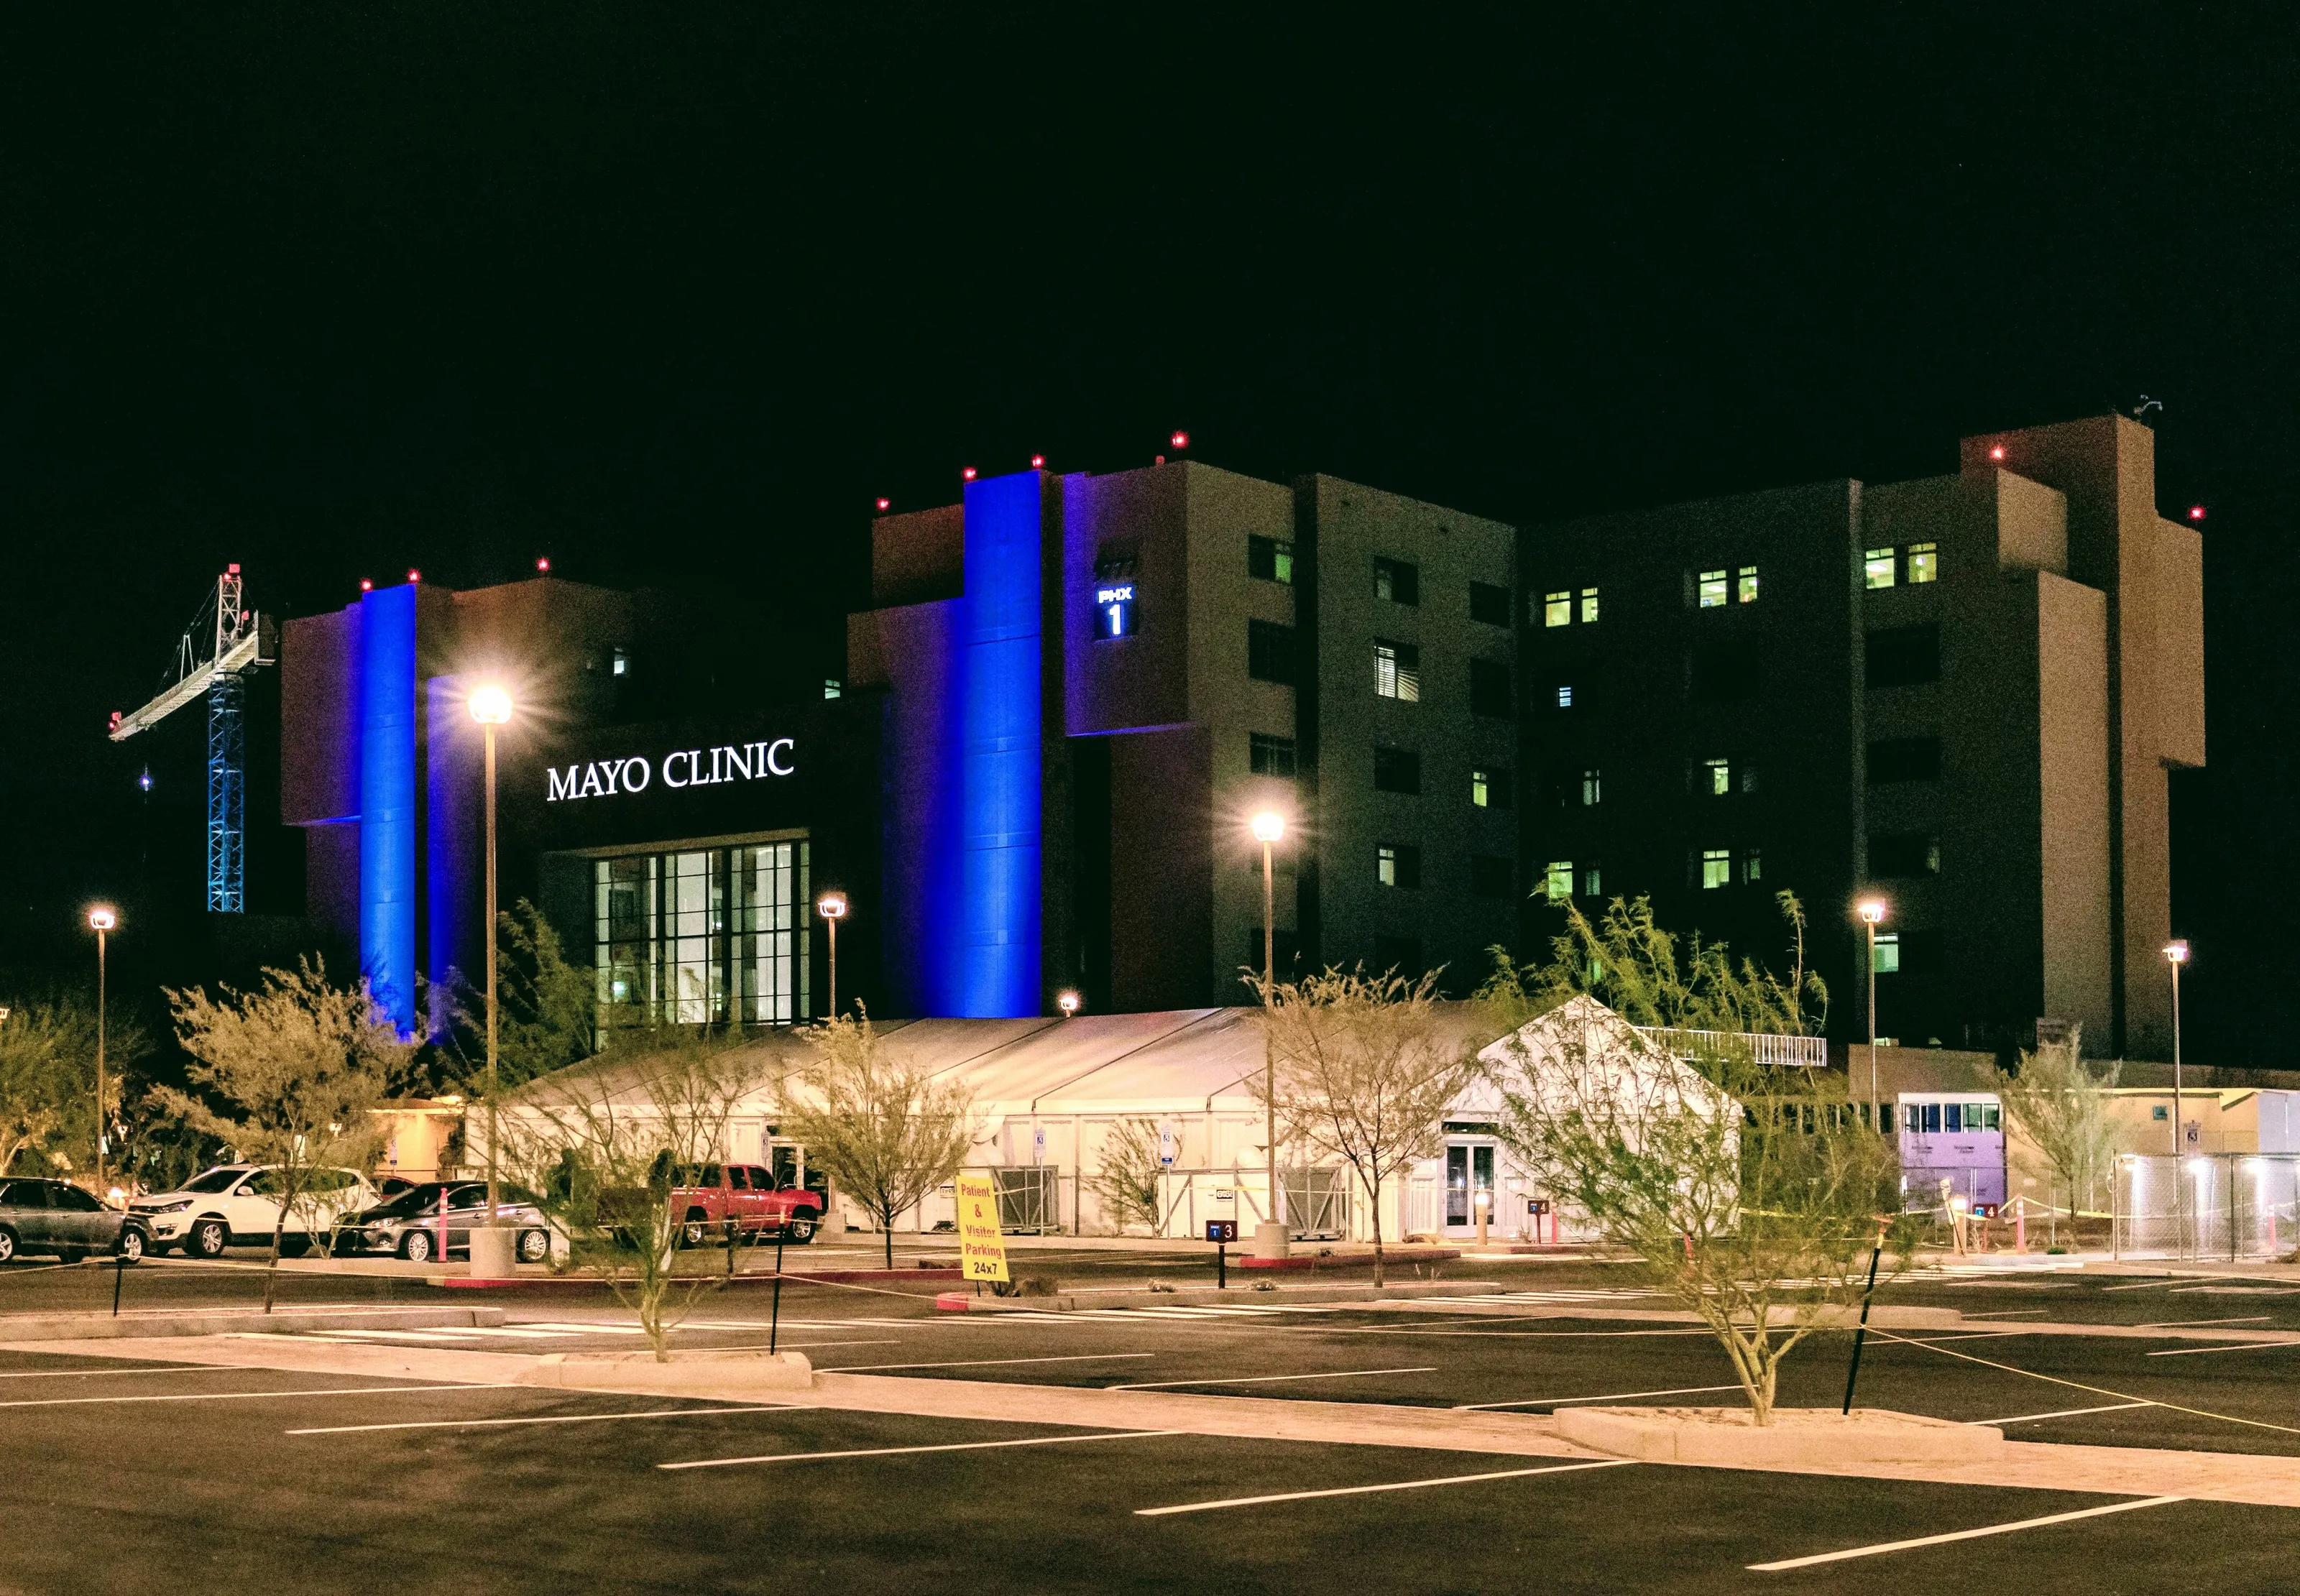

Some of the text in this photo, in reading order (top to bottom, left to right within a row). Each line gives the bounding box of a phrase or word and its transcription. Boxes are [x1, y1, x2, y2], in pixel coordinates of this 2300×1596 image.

[1098, 587, 1132, 603] PHX
[1109, 604, 1121, 635] 1
[546, 739, 794, 801] MAYO CLINIC
[961, 1184, 990, 1197] Patient
[975, 1204, 983, 1218] &
[1540, 1203, 1546, 1212] 4
[1987, 1207, 1995, 1217] 4
[966, 1224, 995, 1237] Visitor
[1225, 1224, 1233, 1238] 3
[965, 1243, 1002, 1259] Parking
[973, 1262, 997, 1275] 24x7
